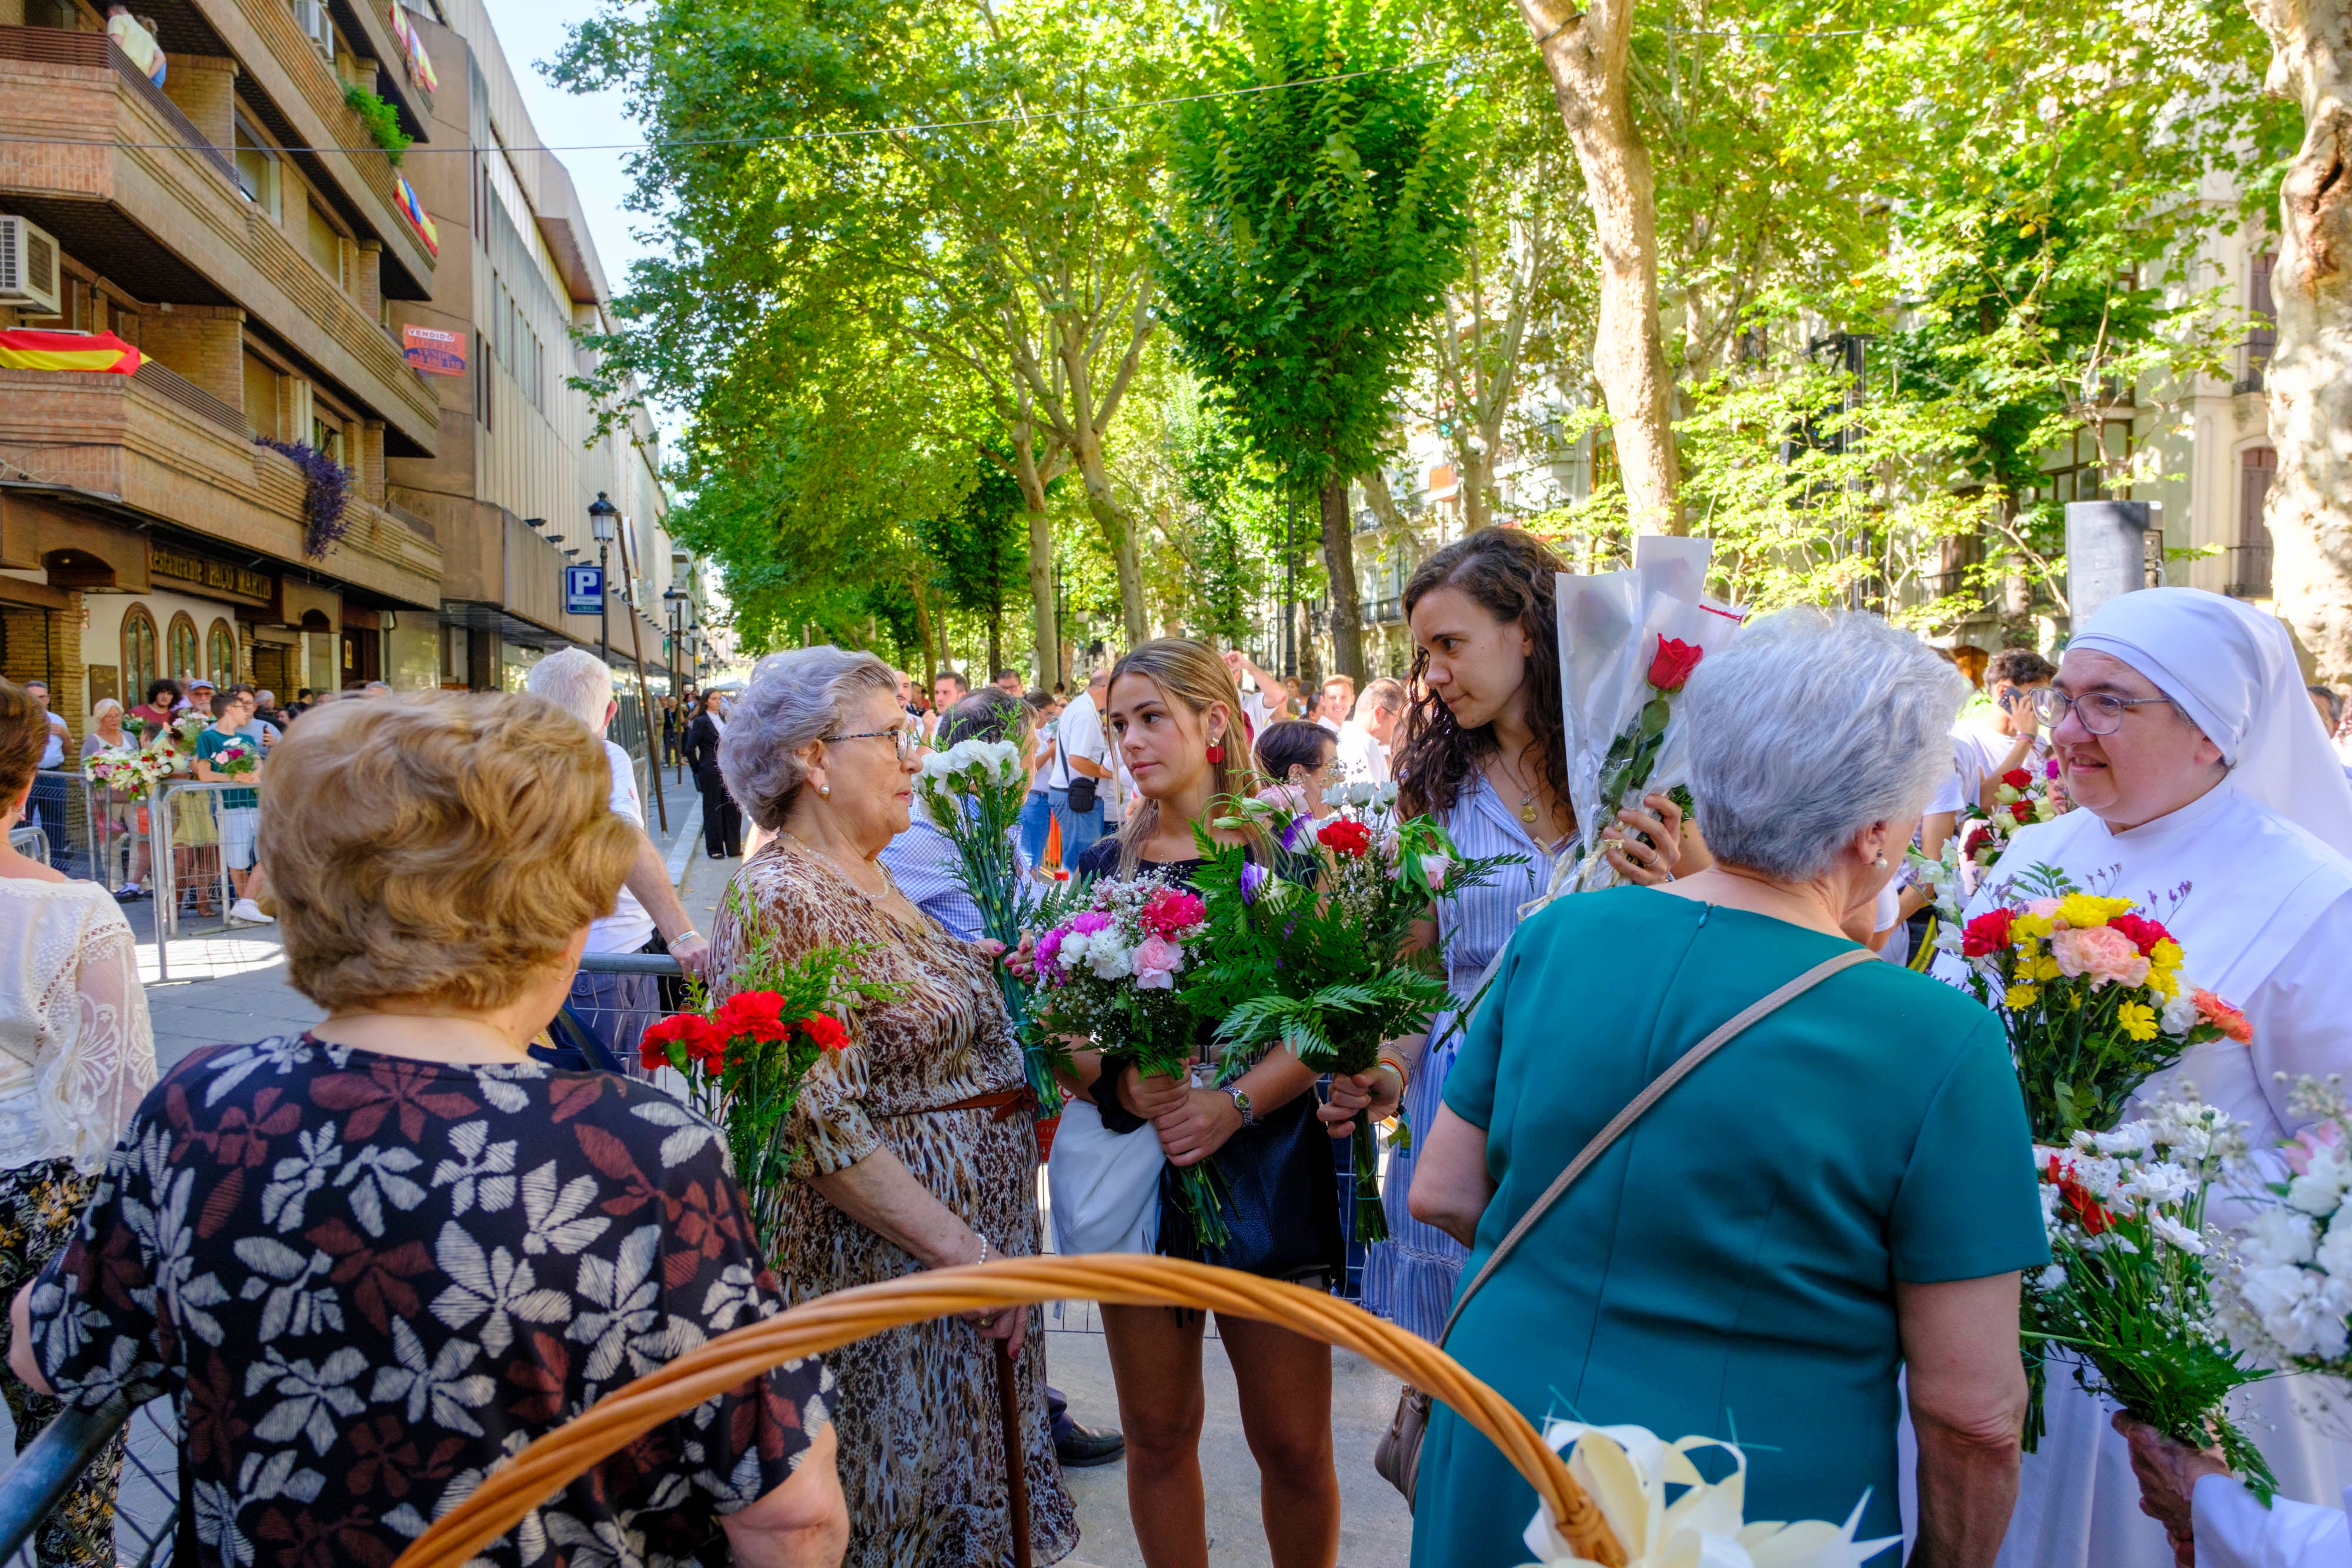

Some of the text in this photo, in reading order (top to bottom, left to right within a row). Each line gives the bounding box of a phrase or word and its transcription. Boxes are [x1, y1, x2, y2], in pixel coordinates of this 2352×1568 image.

[408, 329, 453, 340] VENDIDO
[414, 338, 457, 352] TORRES
[418, 348, 451, 360] VENDE
[575, 572, 597, 594] P
